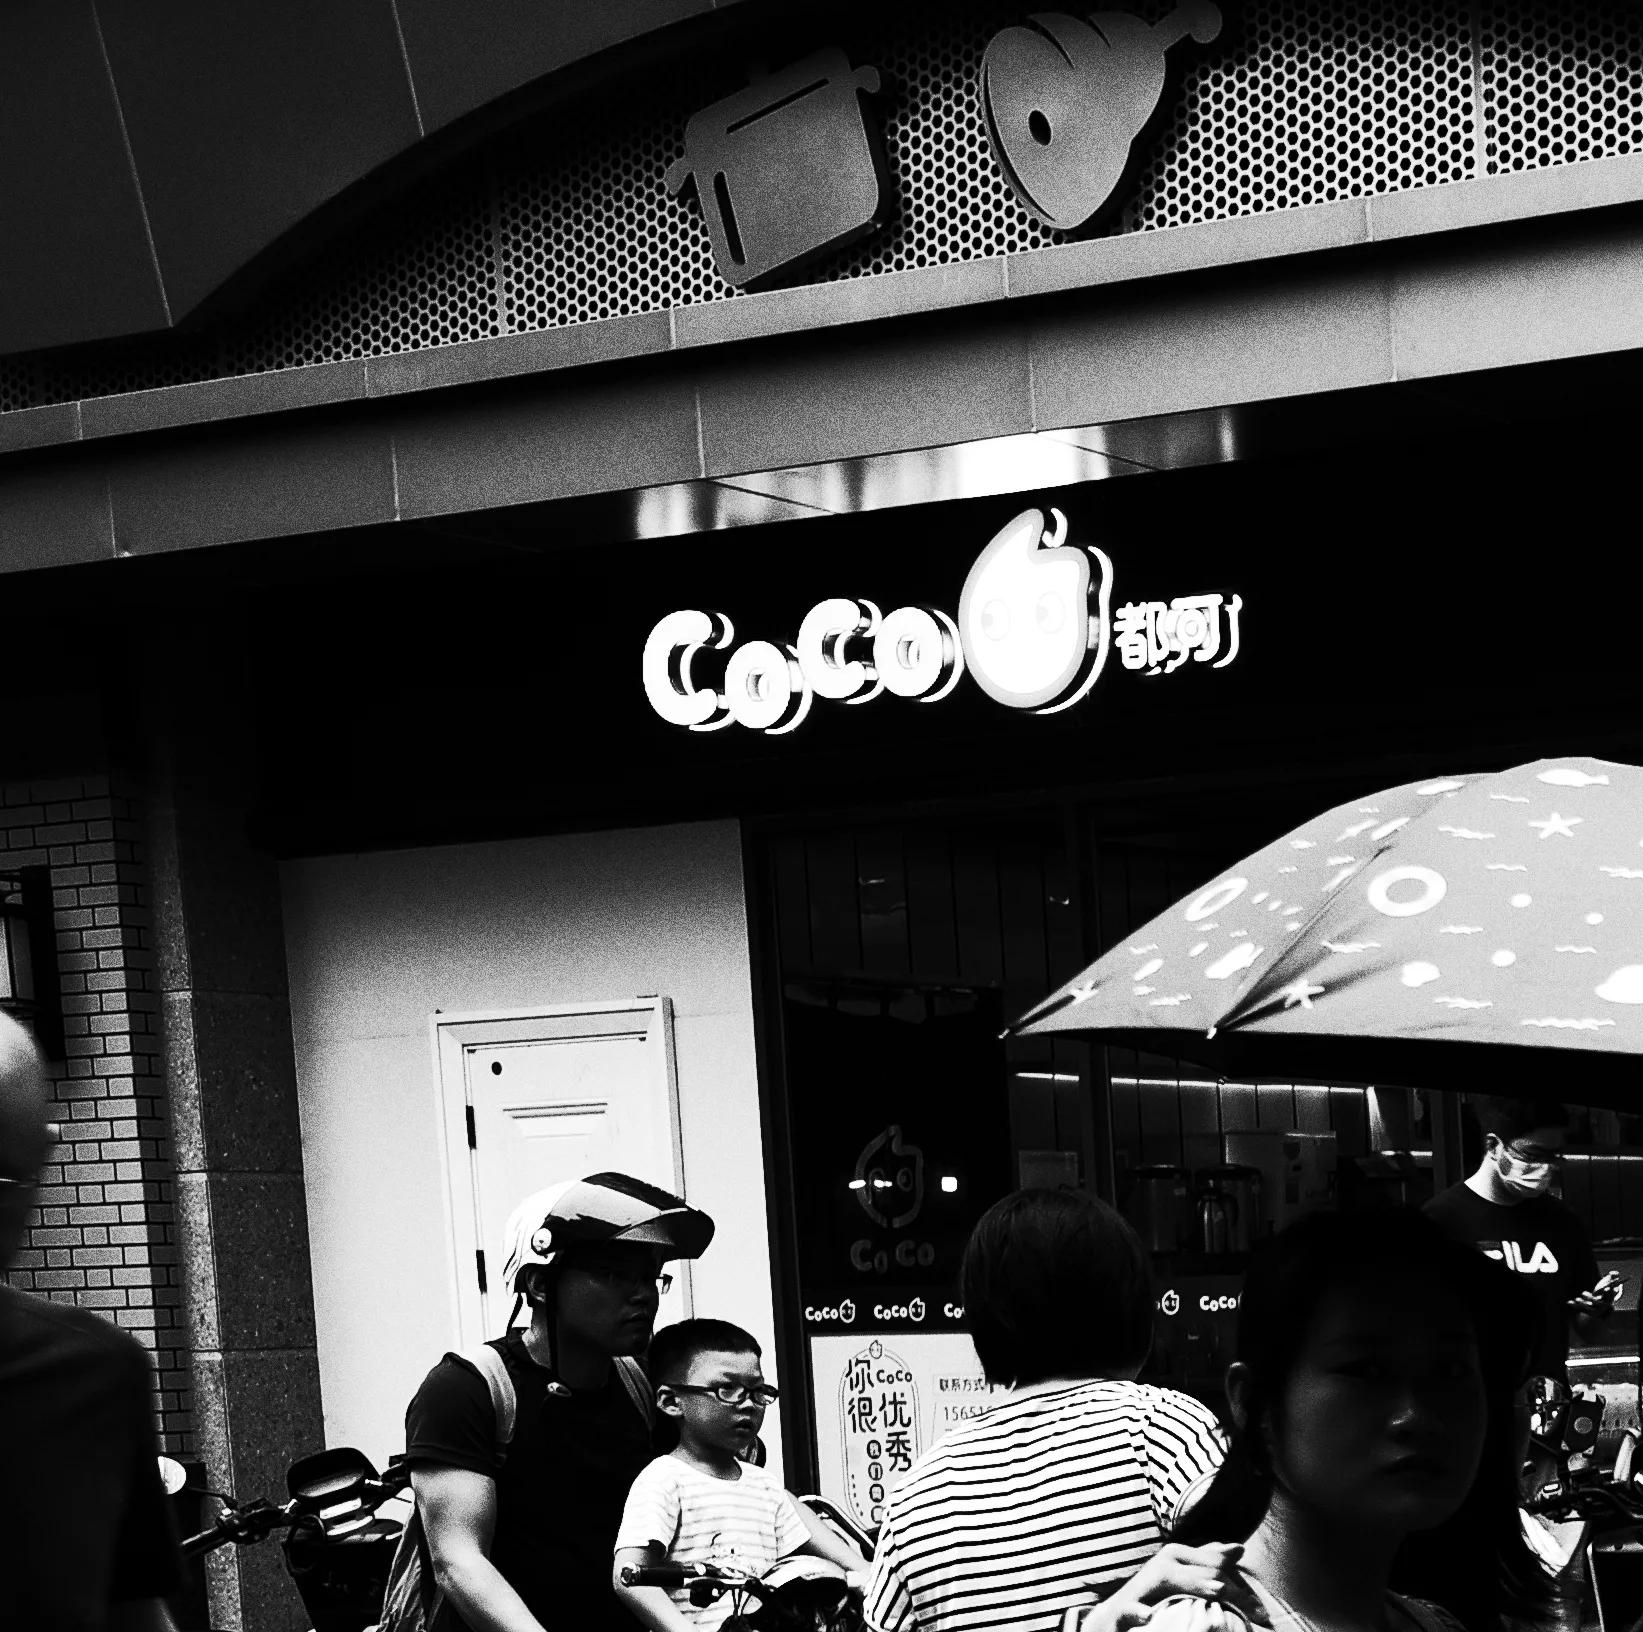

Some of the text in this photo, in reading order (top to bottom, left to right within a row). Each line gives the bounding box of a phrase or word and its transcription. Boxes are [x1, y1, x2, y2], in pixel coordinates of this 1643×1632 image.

[1112, 592, 1243, 674] 都可
[642, 597, 966, 734] CoCo
[850, 1238, 936, 1276] CoCo
[804, 1302, 965, 1322] CoCo CoCo Co
[875, 1369, 913, 1385] CoCo
